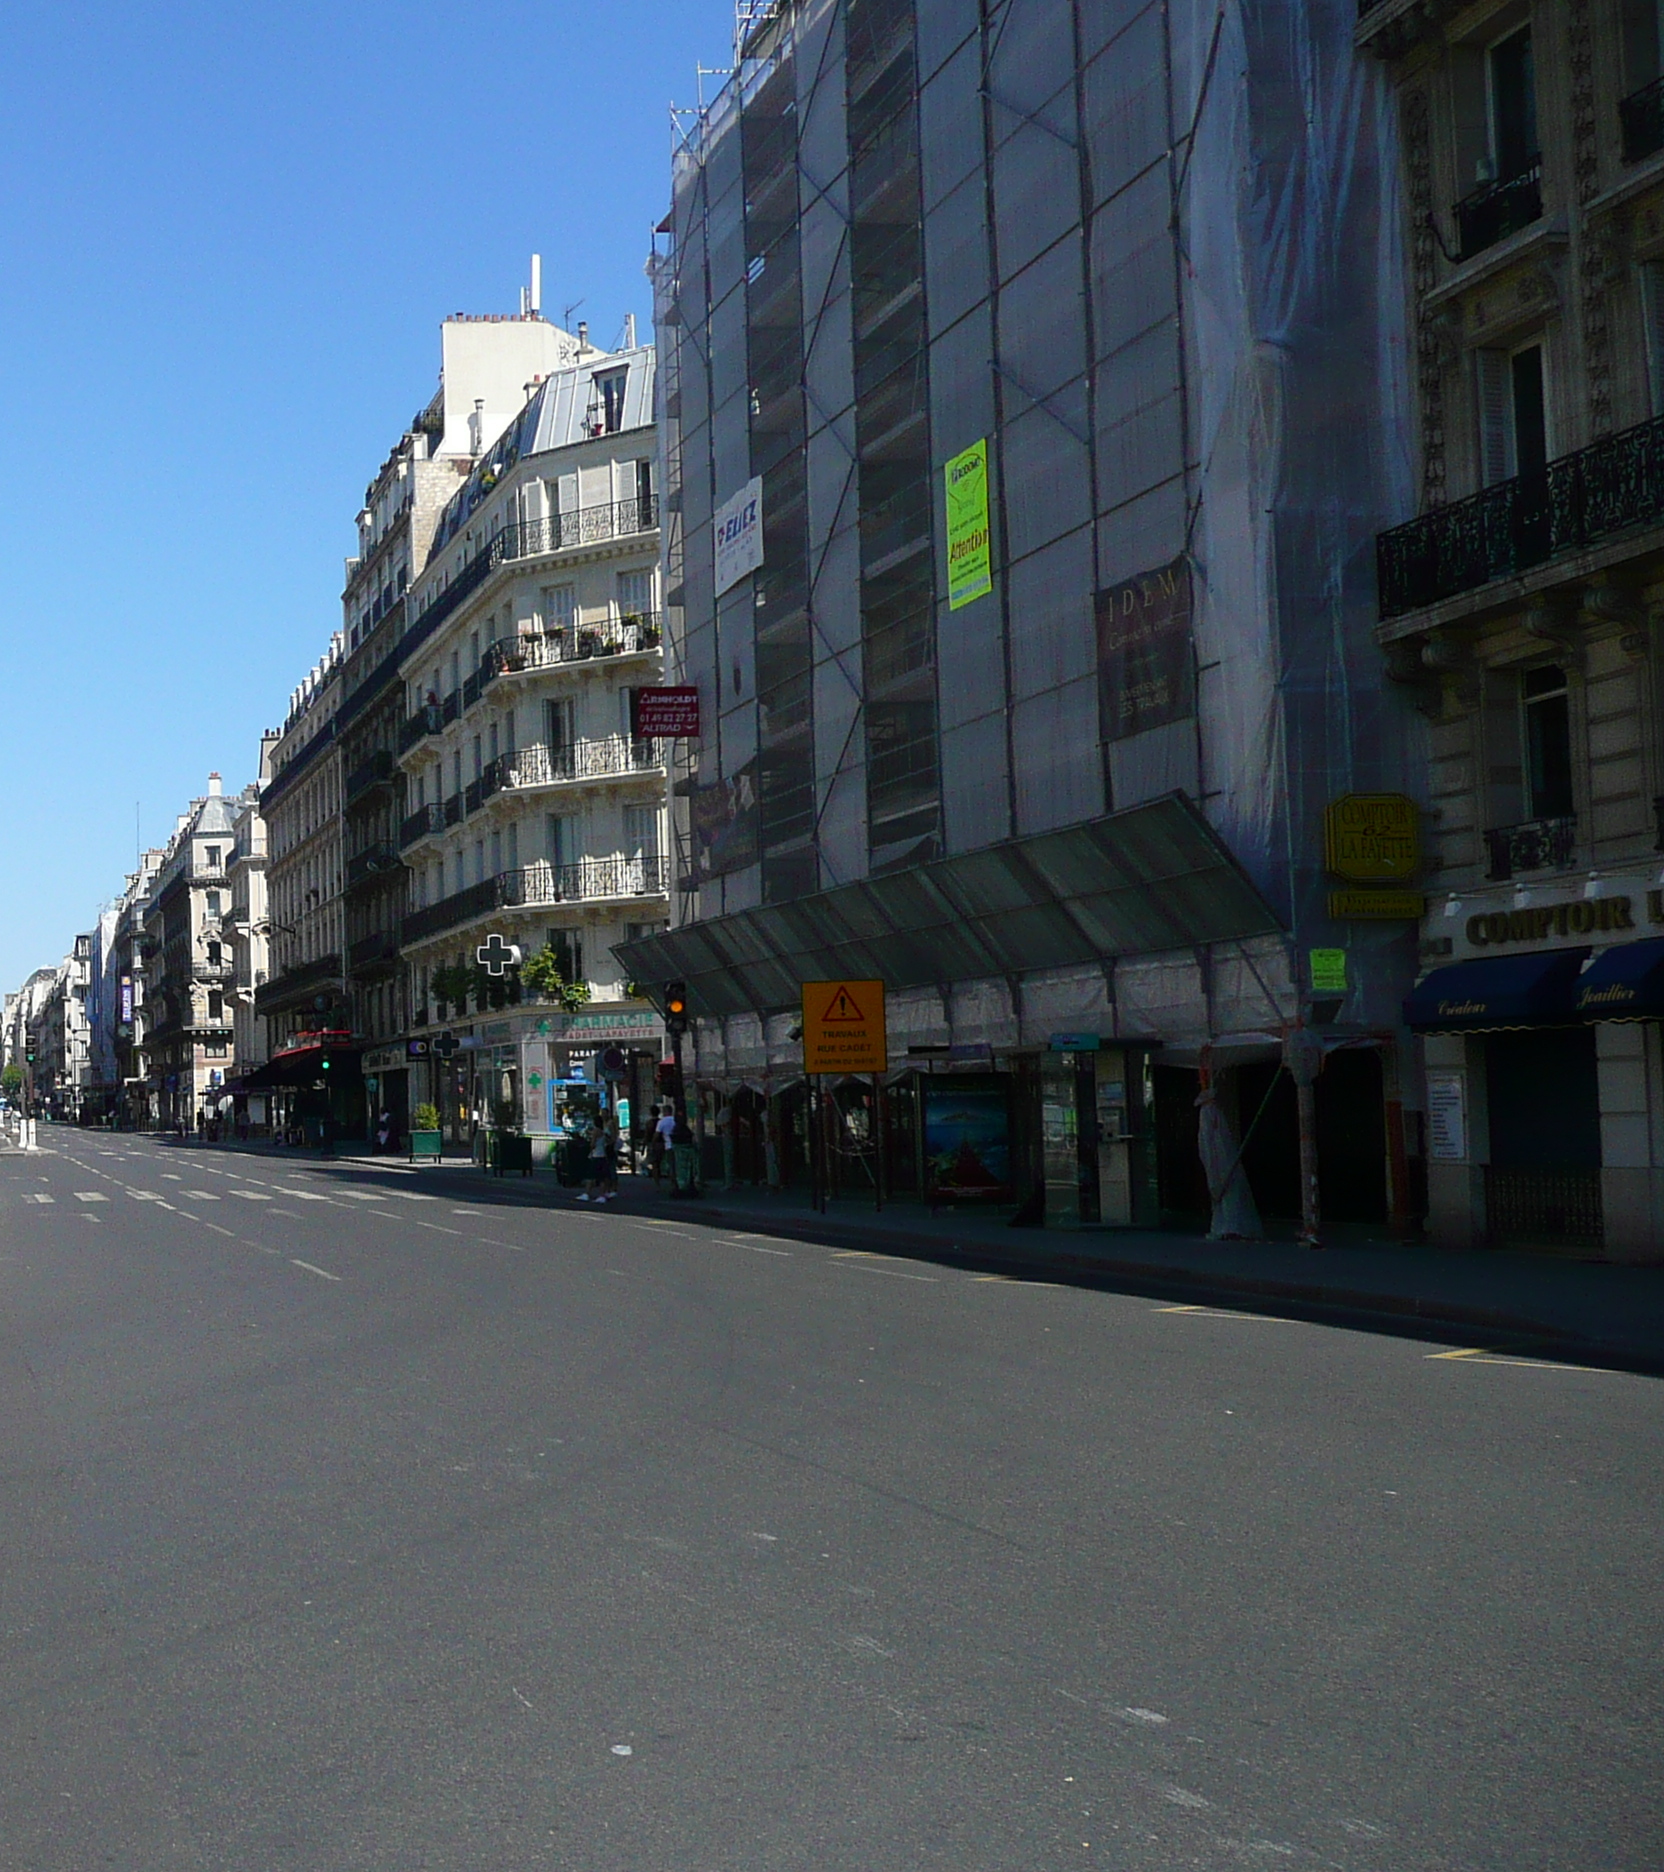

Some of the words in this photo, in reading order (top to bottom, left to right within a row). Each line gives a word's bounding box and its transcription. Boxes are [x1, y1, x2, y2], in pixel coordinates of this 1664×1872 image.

[949, 528, 988, 564] Attention
[1108, 569, 1176, 622] IDEM
[1341, 803, 1409, 825] COMPTOIR
[1363, 825, 1391, 836] 62
[1466, 896, 1635, 946] COMPTOIR
[561, 1012, 654, 1030] PHARMACIE
[823, 1030, 868, 1039] TRAVAUX
[817, 1044, 836, 1053] RUE
